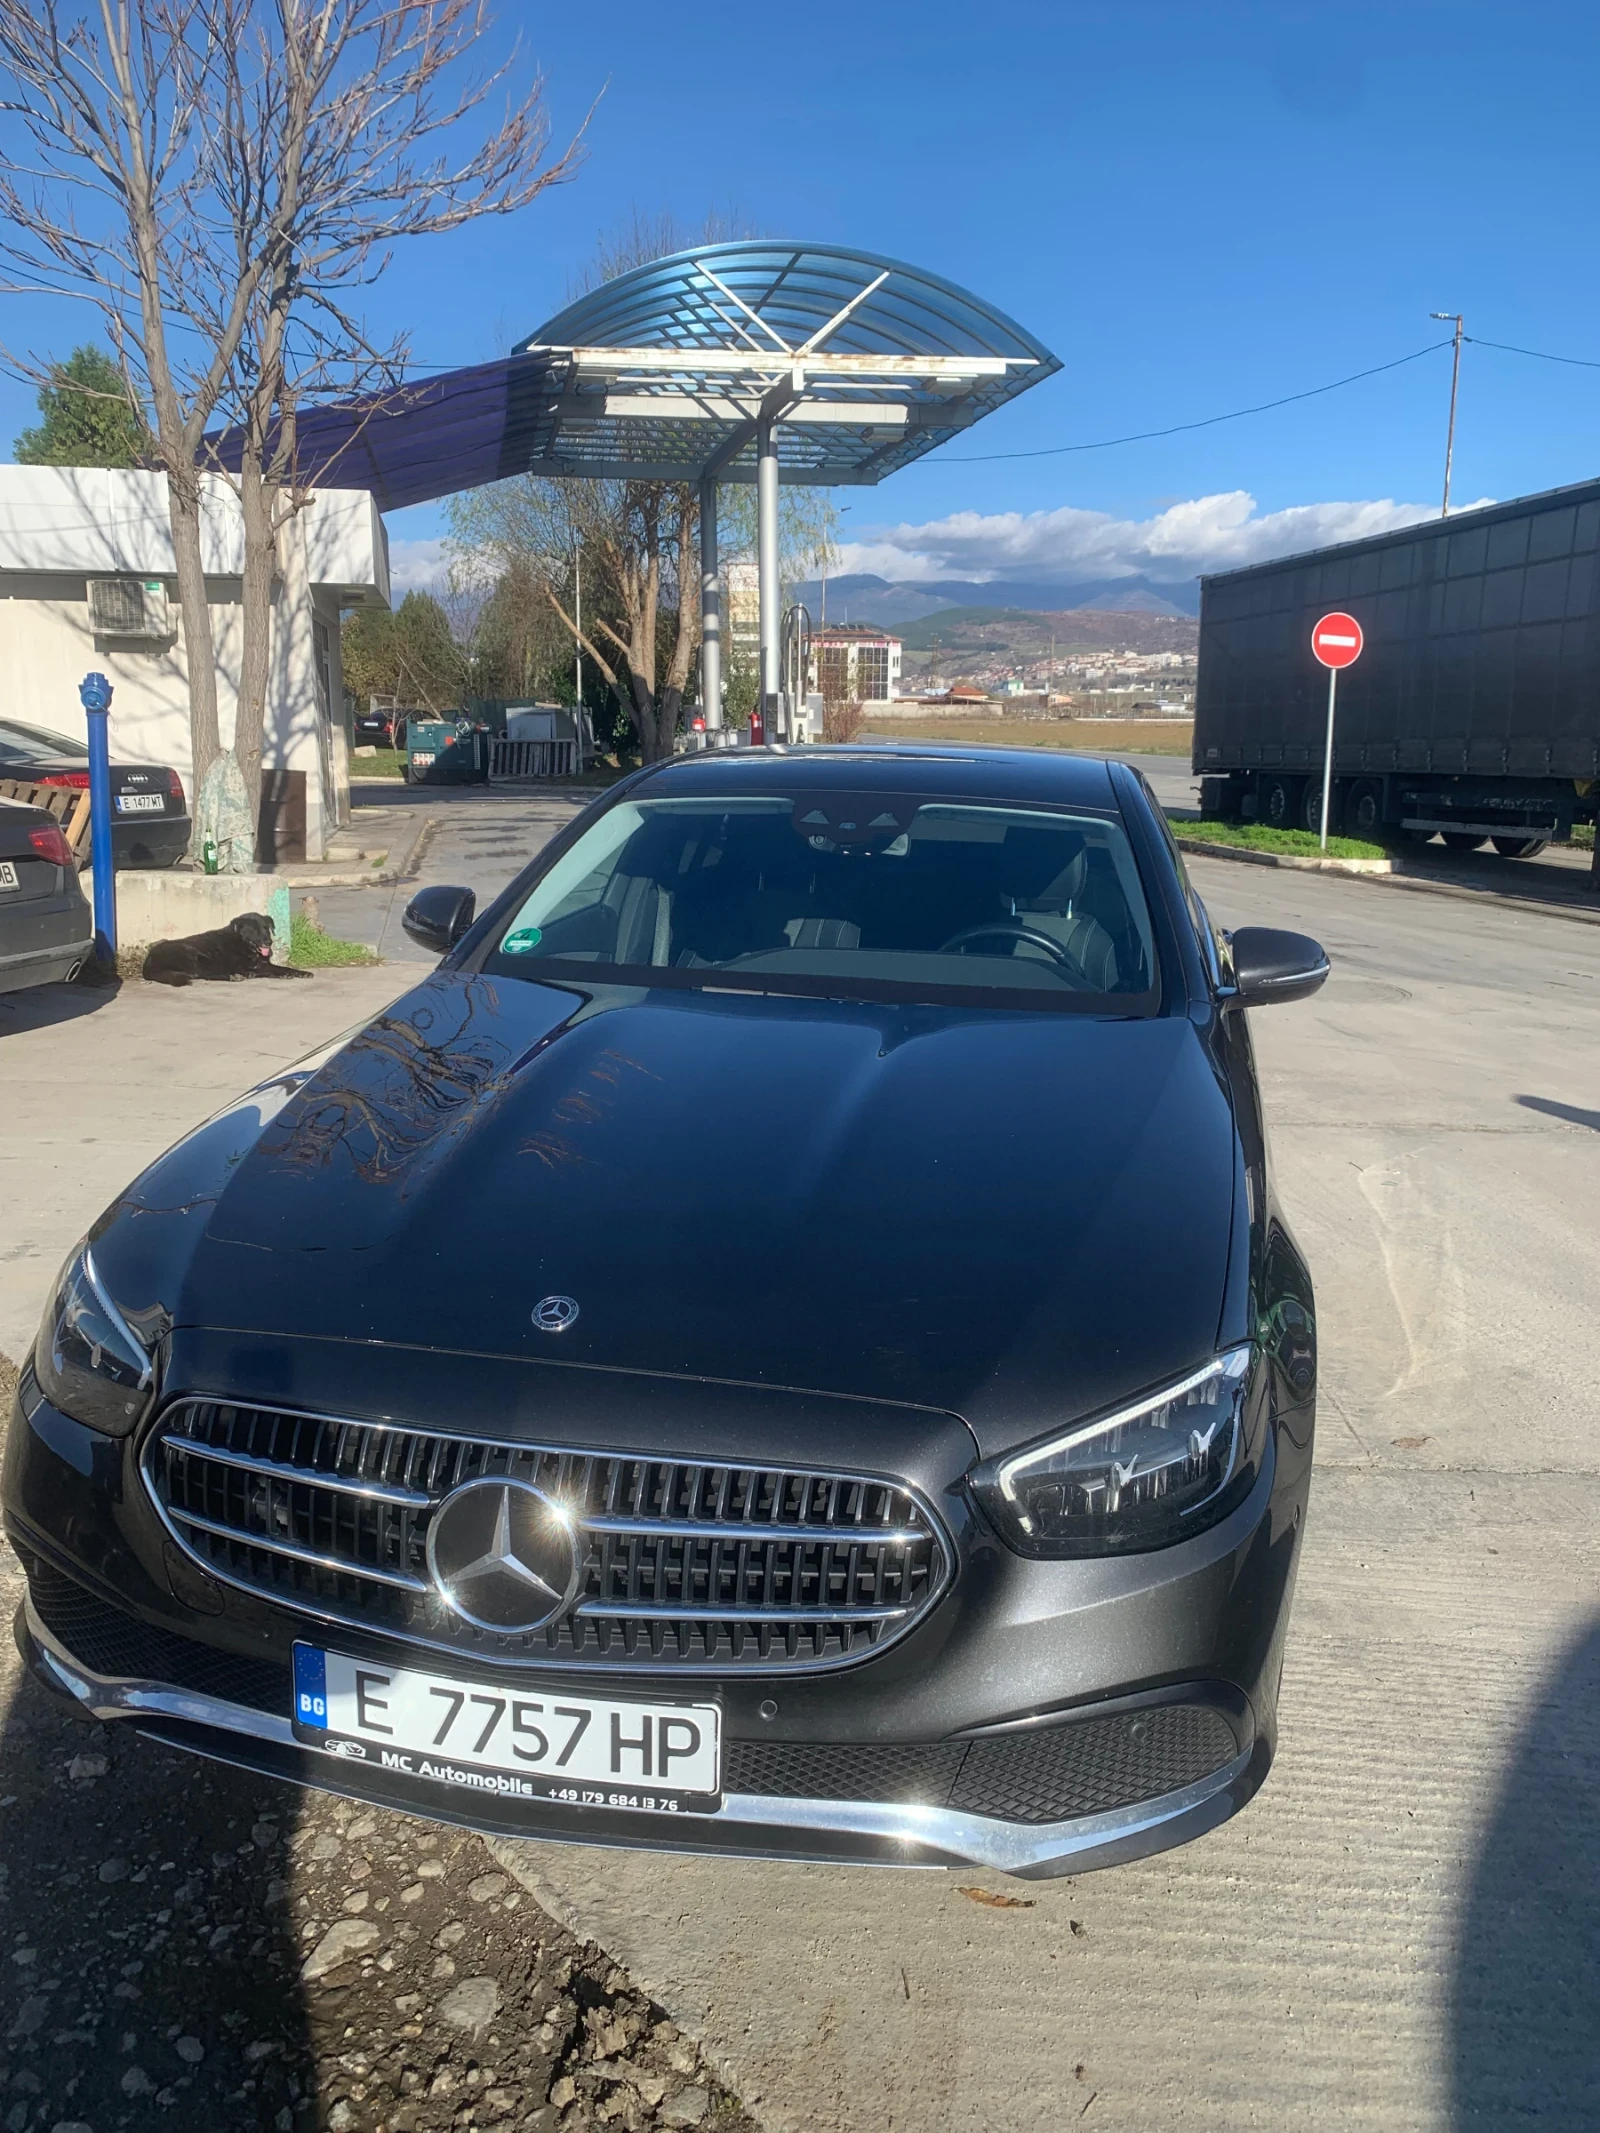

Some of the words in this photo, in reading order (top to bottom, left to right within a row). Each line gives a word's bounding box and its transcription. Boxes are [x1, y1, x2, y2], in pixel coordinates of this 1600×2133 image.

[123, 797, 130, 808] E
[300, 1693, 325, 1716] BG
[356, 1669, 393, 1735] E
[430, 1686, 592, 1766] 7757
[610, 1712, 701, 1777] HP
[381, 1751, 412, 1771] MC
[419, 1760, 533, 1795] Automobile
[548, 1789, 578, 1801] +49
[582, 1791, 604, 1803] 179
[609, 1793, 638, 1807] 684
[643, 1797, 655, 1808] 13
[660, 1798, 678, 1811] 76
